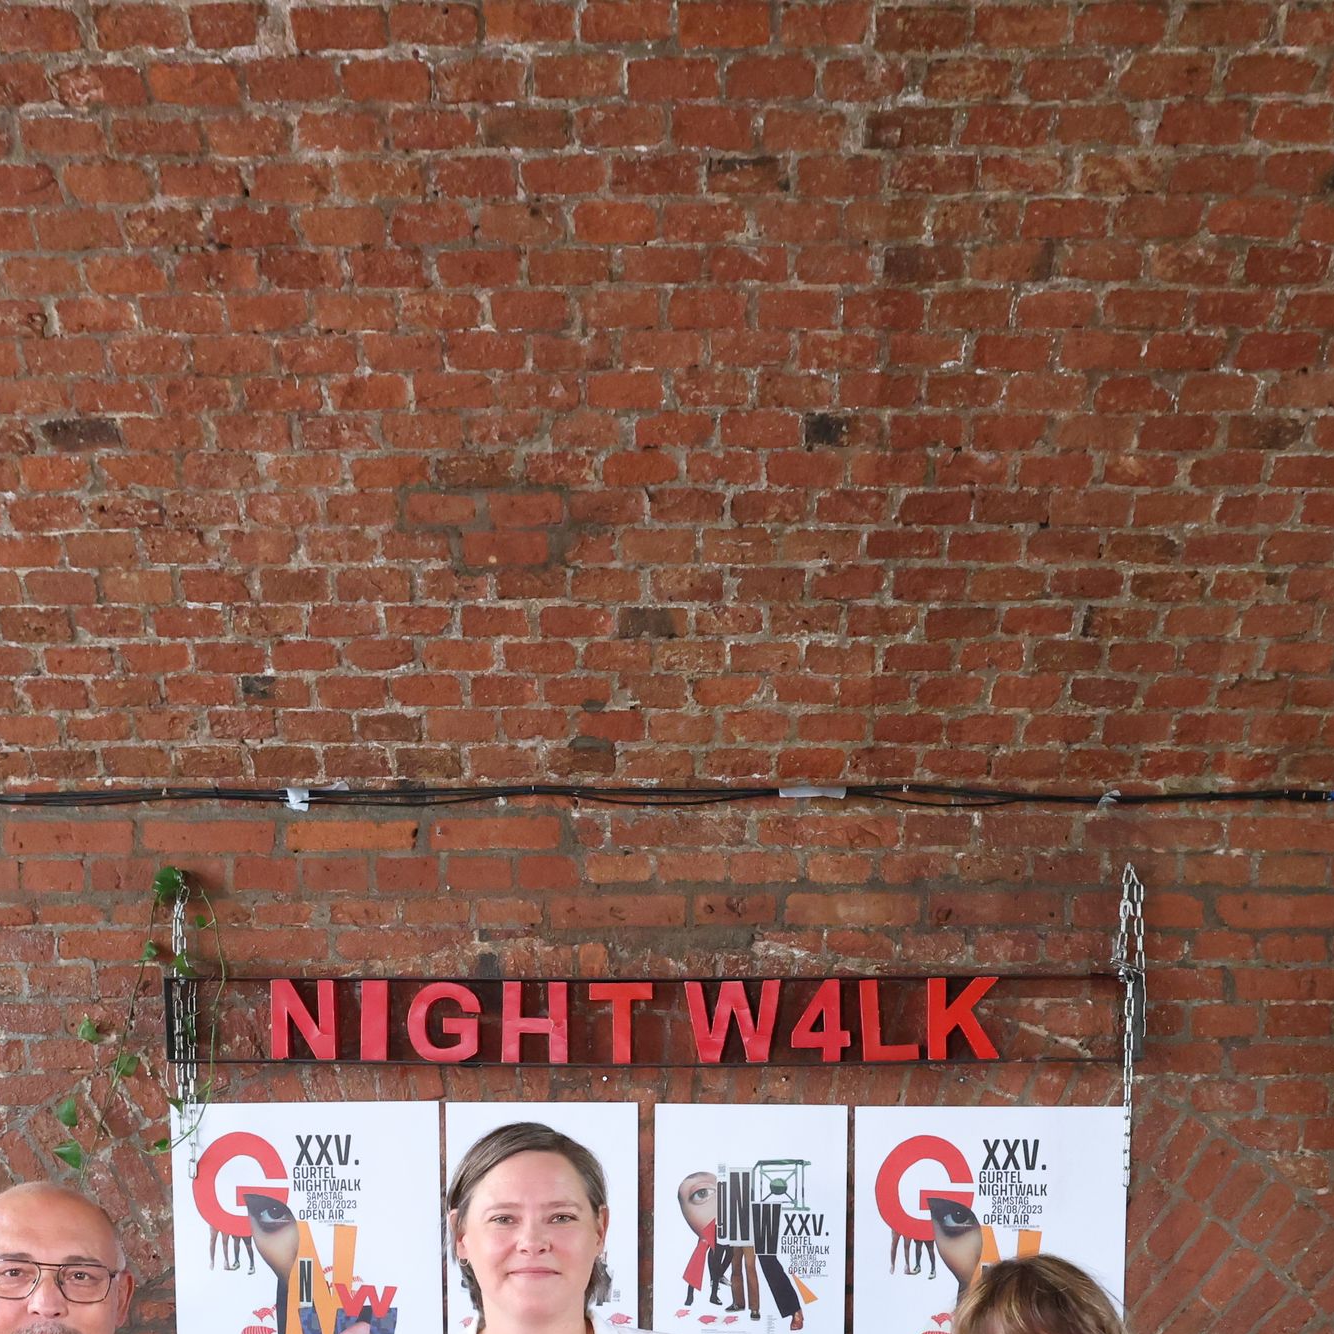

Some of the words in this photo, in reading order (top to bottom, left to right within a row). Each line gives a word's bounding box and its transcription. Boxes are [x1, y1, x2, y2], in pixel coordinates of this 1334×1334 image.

[270, 979, 653, 1064] NIGHT
[684, 977, 1000, 1063] W4LK
[295, 1134, 360, 1167] XXV.
[982, 1138, 1047, 1171] XXV.
[293, 1163, 336, 1180] GÜRTEL
[979, 1167, 1023, 1184] GÜRTEL
[293, 1179, 361, 1192] NIGHTWALK
[979, 1184, 1048, 1197] NIGHTWALK
[306, 1191, 343, 1201] SAMSTAG
[992, 1196, 1029, 1206] SAMSTAG
[306, 1200, 357, 1210] 26/08/2023
[992, 1205, 1043, 1214] 26/08/2023
[299, 1209, 325, 1220] OPEN
[328, 1209, 345, 1220] AIR
[983, 1214, 1010, 1225] OPEN
[1013, 1214, 1030, 1225] AIR
[783, 1213, 829, 1236] XXV.
[781, 1234, 813, 1246] GÜRTEL
[781, 1245, 830, 1255] NIGHTWALK
[790, 1260, 827, 1268] 26/08/2023
[788, 1266, 807, 1275] OPEN
[809, 1266, 822, 1275] AIR
